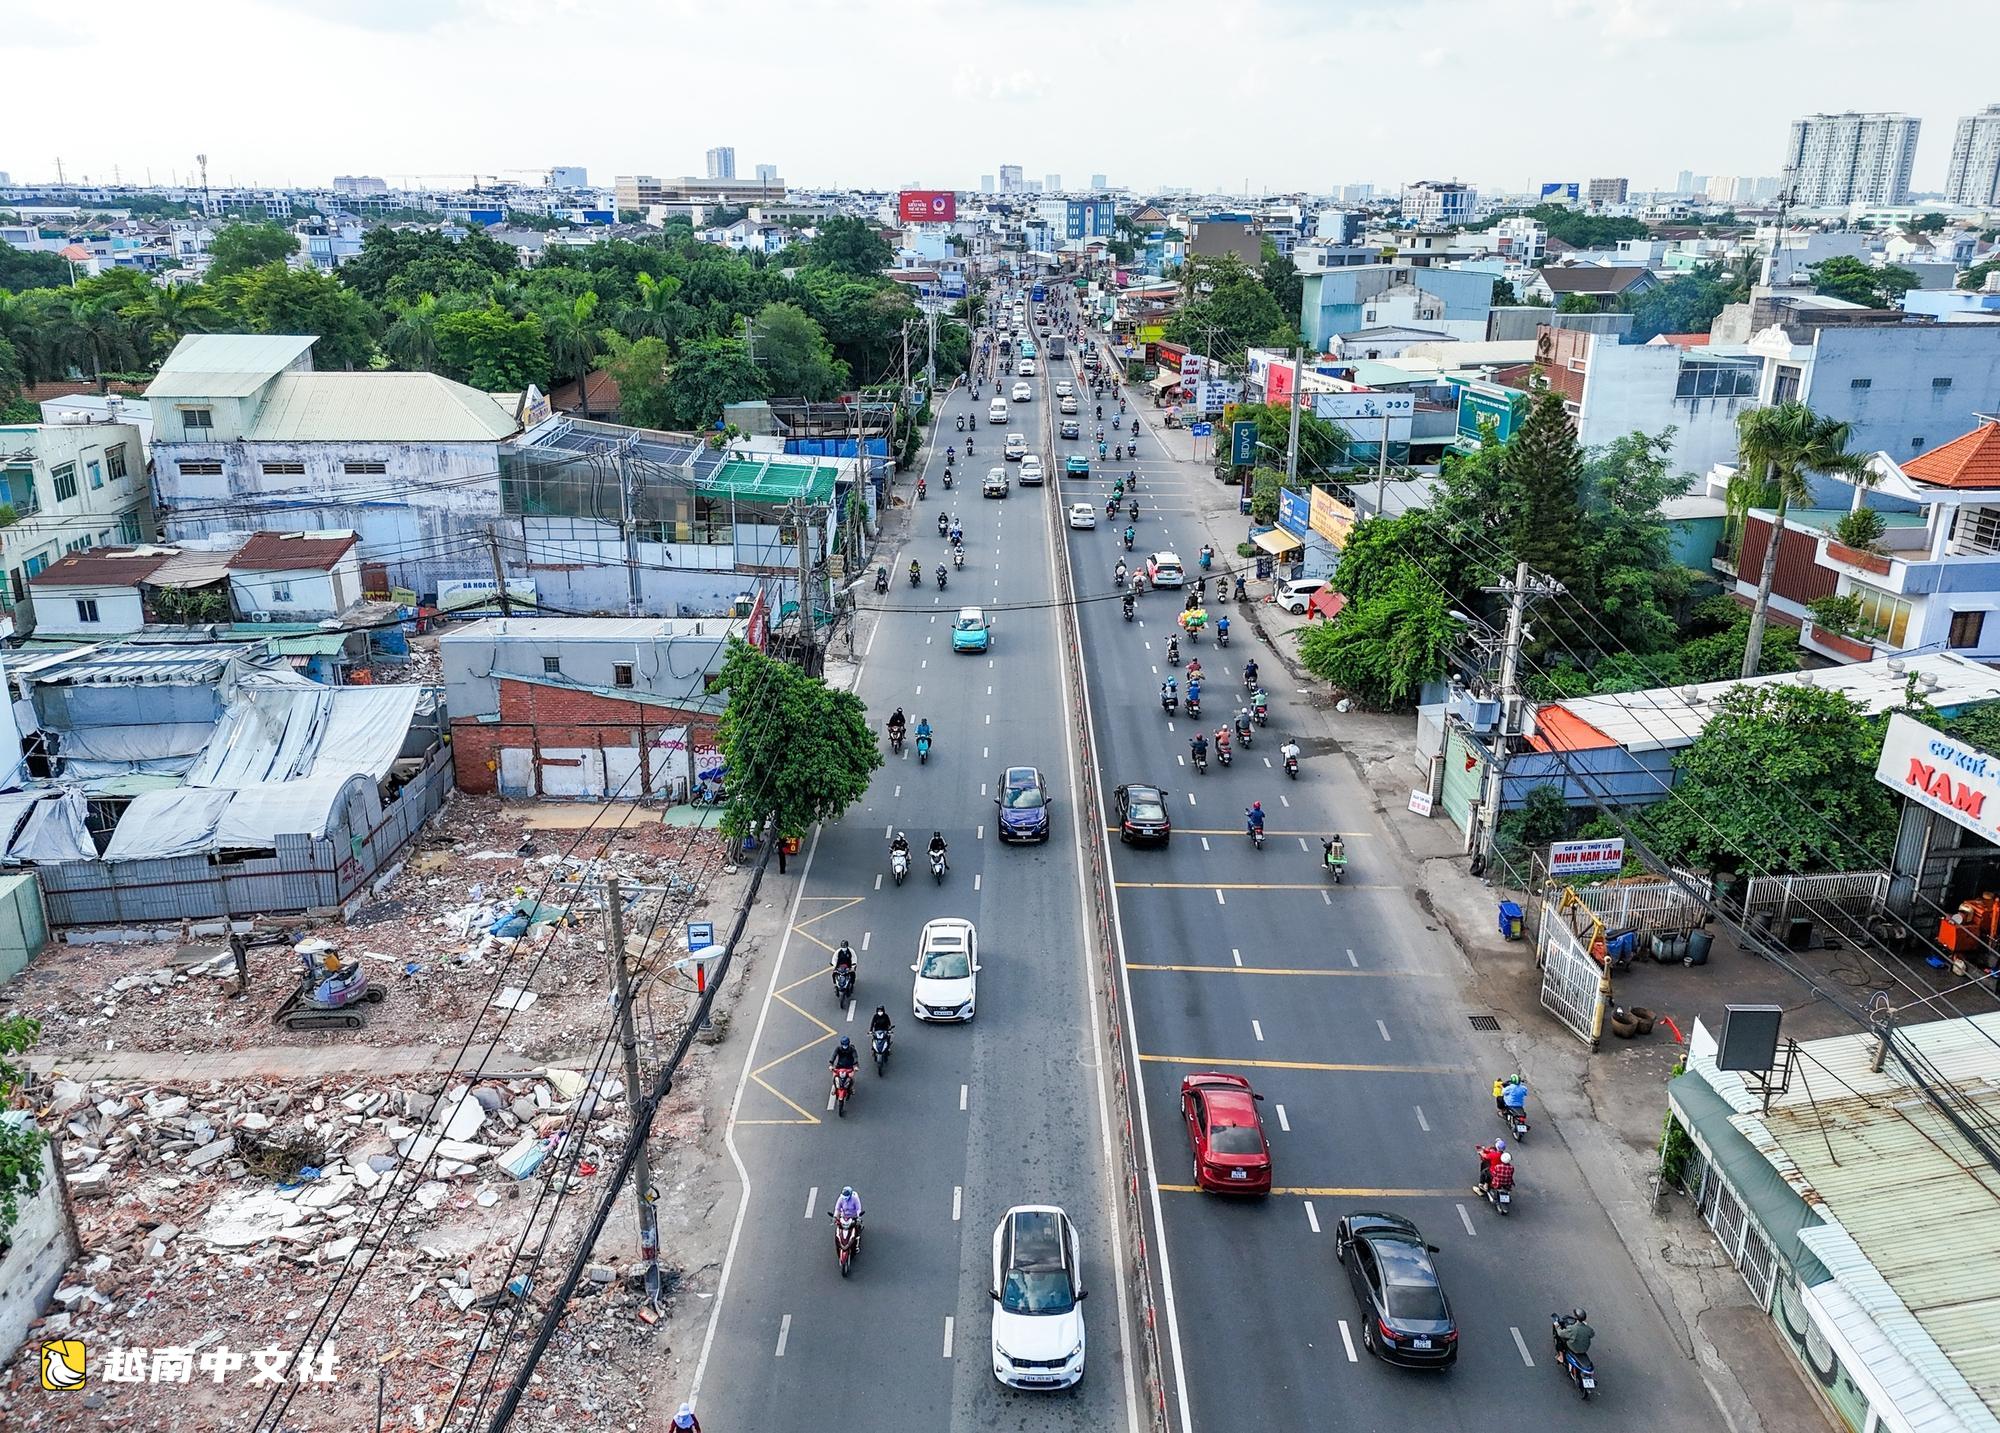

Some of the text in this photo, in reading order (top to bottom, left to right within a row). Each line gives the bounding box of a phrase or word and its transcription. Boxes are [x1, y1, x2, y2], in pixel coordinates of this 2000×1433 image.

[1241, 436, 1250, 459] BIDV
[1929, 740, 1954, 760] CƠ
[1955, 752, 1987, 778] KHÍ
[1905, 758, 1987, 820] NAM
[1553, 848, 1621, 864] MINH NAM LÂM
